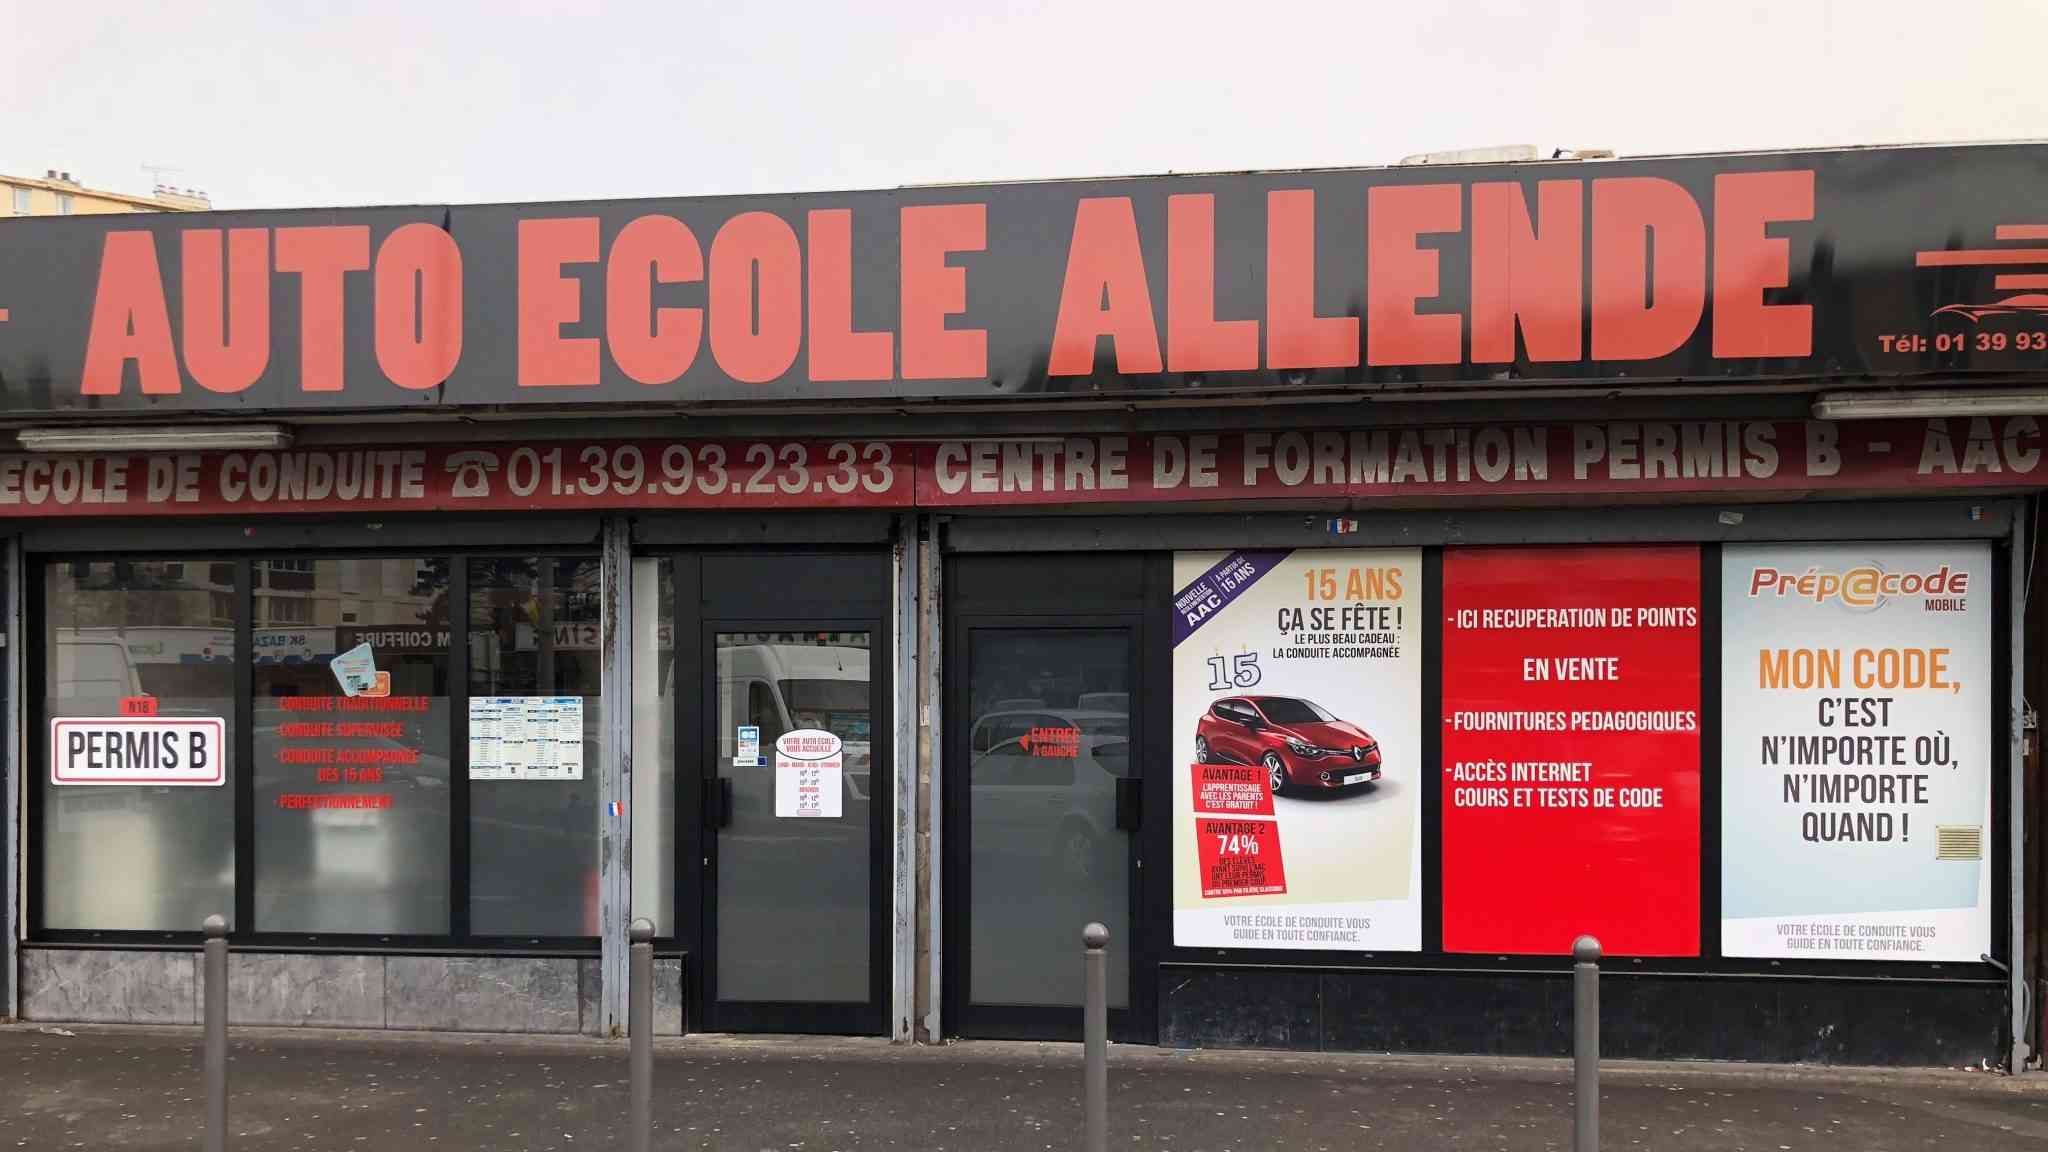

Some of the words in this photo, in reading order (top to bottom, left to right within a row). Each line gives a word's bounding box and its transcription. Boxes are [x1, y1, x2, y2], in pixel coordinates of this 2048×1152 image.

[81, 223, 463, 393] AUTO
[518, 203, 987, 386] ECOLE
[1047, 170, 1815, 376] ALLENDE
[1878, 334, 1927, 352] Tél:
[1935, 333, 1965, 352] 01
[1975, 332, 2007, 351] 39
[2015, 331, 2048, 350] 93
[935, 437, 1128, 494] CENTRE
[1152, 433, 1219, 488] DE
[1243, 427, 1547, 487] FORMATION
[1574, 421, 1779, 480] PERMIS
[1805, 421, 1841, 477] B
[1917, 415, 2041, 475] AAC
[147, 456, 200, 502] DE
[219, 451, 425, 501] CONDUITE
[507, 442, 894, 496] 01.39.93.23.33
[1221, 577, 1236, 592] 15
[1234, 562, 1255, 583] ANS
[1304, 568, 1337, 601] 15
[1344, 568, 1403, 601] ANS
[1750, 566, 1969, 606] Prép@code
[1175, 581, 1208, 610] NOUVELLE
[1925, 599, 1966, 612] MOBILE
[1186, 594, 1221, 627] AAC
[1278, 607, 1305, 635] ÇA
[1311, 607, 1335, 630] SE
[1342, 602, 1390, 630] FÊTE
[1483, 608, 1606, 629] RECUPERATION
[1611, 608, 1632, 628] DE
[1637, 607, 1697, 627] POINTS
[1295, 634, 1305, 645] LE
[1308, 634, 1330, 645] PLUS
[1332, 634, 1356, 645] BEAU
[1358, 634, 1394, 645] CADEAU
[1273, 648, 1284, 659] LA
[1286, 648, 1330, 659] CONDUITE
[1207, 651, 1262, 690] 15
[1523, 658, 1548, 681] EN
[1554, 657, 1619, 681] VENTE
[1759, 649, 1840, 689] MON
[1853, 648, 1961, 694] CODE,
[1571, 711, 1696, 731] PEDAGOGIQUES
[1818, 697, 1893, 727] C'EST
[68, 731, 179, 769] PERMIS
[189, 731, 207, 769] B
[1761, 735, 1906, 766] N'IMPORTE
[1914, 730, 1958, 769] OÙ,
[1202, 767, 1252, 781] AVANTAGE
[1511, 762, 1592, 782] INTERNET
[1200, 791, 1217, 800] AVEC
[1218, 792, 1231, 800] LES
[1232, 792, 1263, 801] PARENTS
[1454, 787, 1509, 808] COURS
[1513, 787, 1534, 808] ET
[1537, 787, 1588, 808] TESTS
[1594, 788, 1615, 808] DE
[1619, 788, 1663, 808] CODE
[1783, 774, 1929, 804] N'IMPORTE
[1225, 800, 1254, 809] GRATUIT
[1206, 822, 1257, 834] AVANTAGE
[1258, 823, 1265, 834] 2
[1802, 812, 1893, 842] QUAND
[1217, 834, 1259, 855] 74%
[1224, 915, 1253, 926] VOTRE
[1285, 917, 1297, 928] DE
[1299, 917, 1344, 929] CONDUITE
[1346, 918, 1371, 930] VOUS
[1777, 924, 1808, 936] VOTRE
[1810, 922, 1841, 937] ÉCOLE
[1843, 925, 1856, 937] DE
[1859, 926, 1908, 938] CONDUITE
[1910, 926, 1936, 939] VOUS
[1233, 930, 1259, 940] GUIDE
[1262, 930, 1274, 941] EN
[1277, 930, 1305, 942] TOUTE
[1307, 931, 1361, 943] CONFIANCE.
[1787, 938, 1816, 950] GUIDE
[1818, 939, 1832, 950] EN
[1834, 939, 1864, 951] TOUTE
